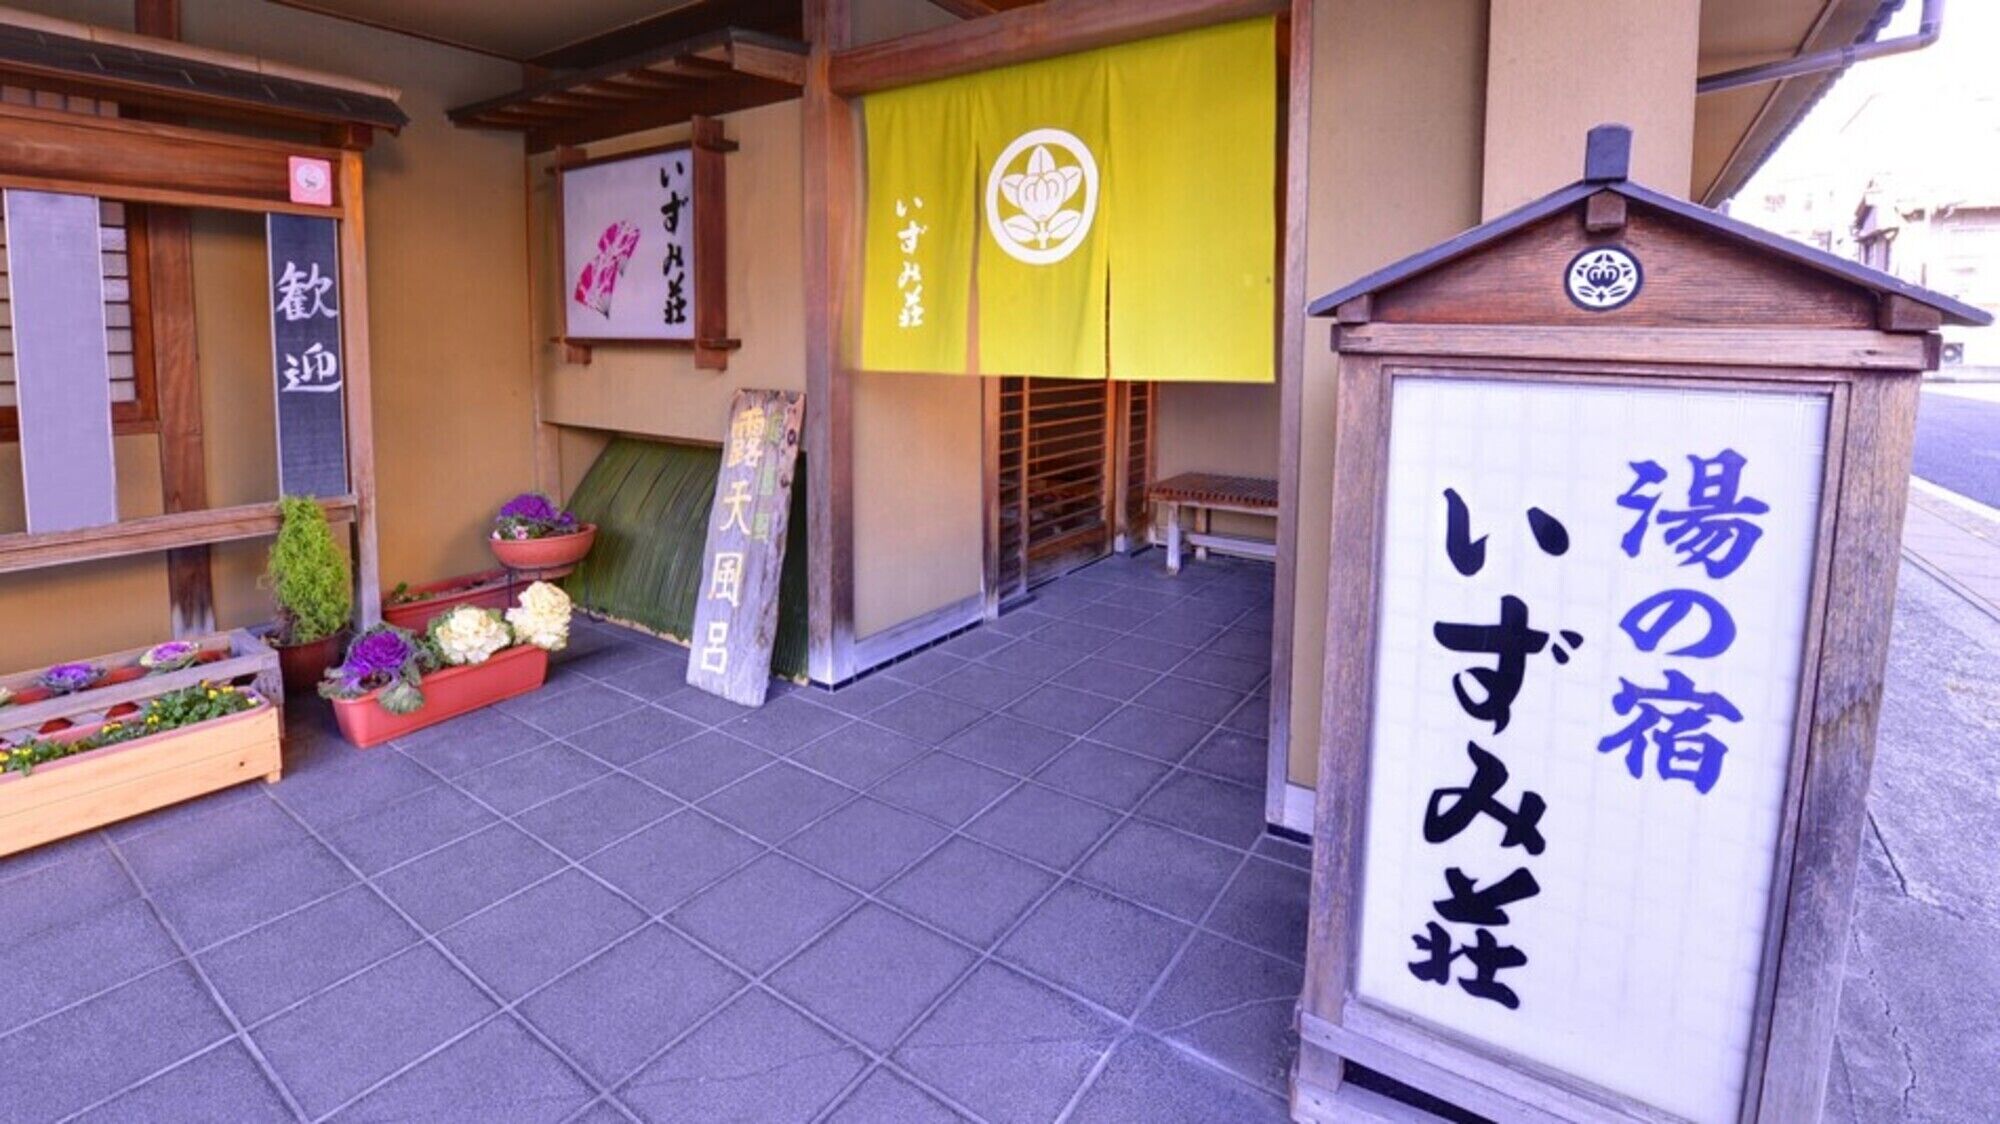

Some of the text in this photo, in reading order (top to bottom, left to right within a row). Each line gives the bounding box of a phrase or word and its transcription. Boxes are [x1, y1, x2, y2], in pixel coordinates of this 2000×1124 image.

[276, 260, 342, 393] 歓迎
[660, 160, 689, 325] いずみ荘
[896, 196, 929, 328] いずみ荘
[700, 407, 766, 676] 露天風呂
[1597, 448, 1770, 795] 湯の宿
[1408, 486, 1584, 1010] いずみ荘
